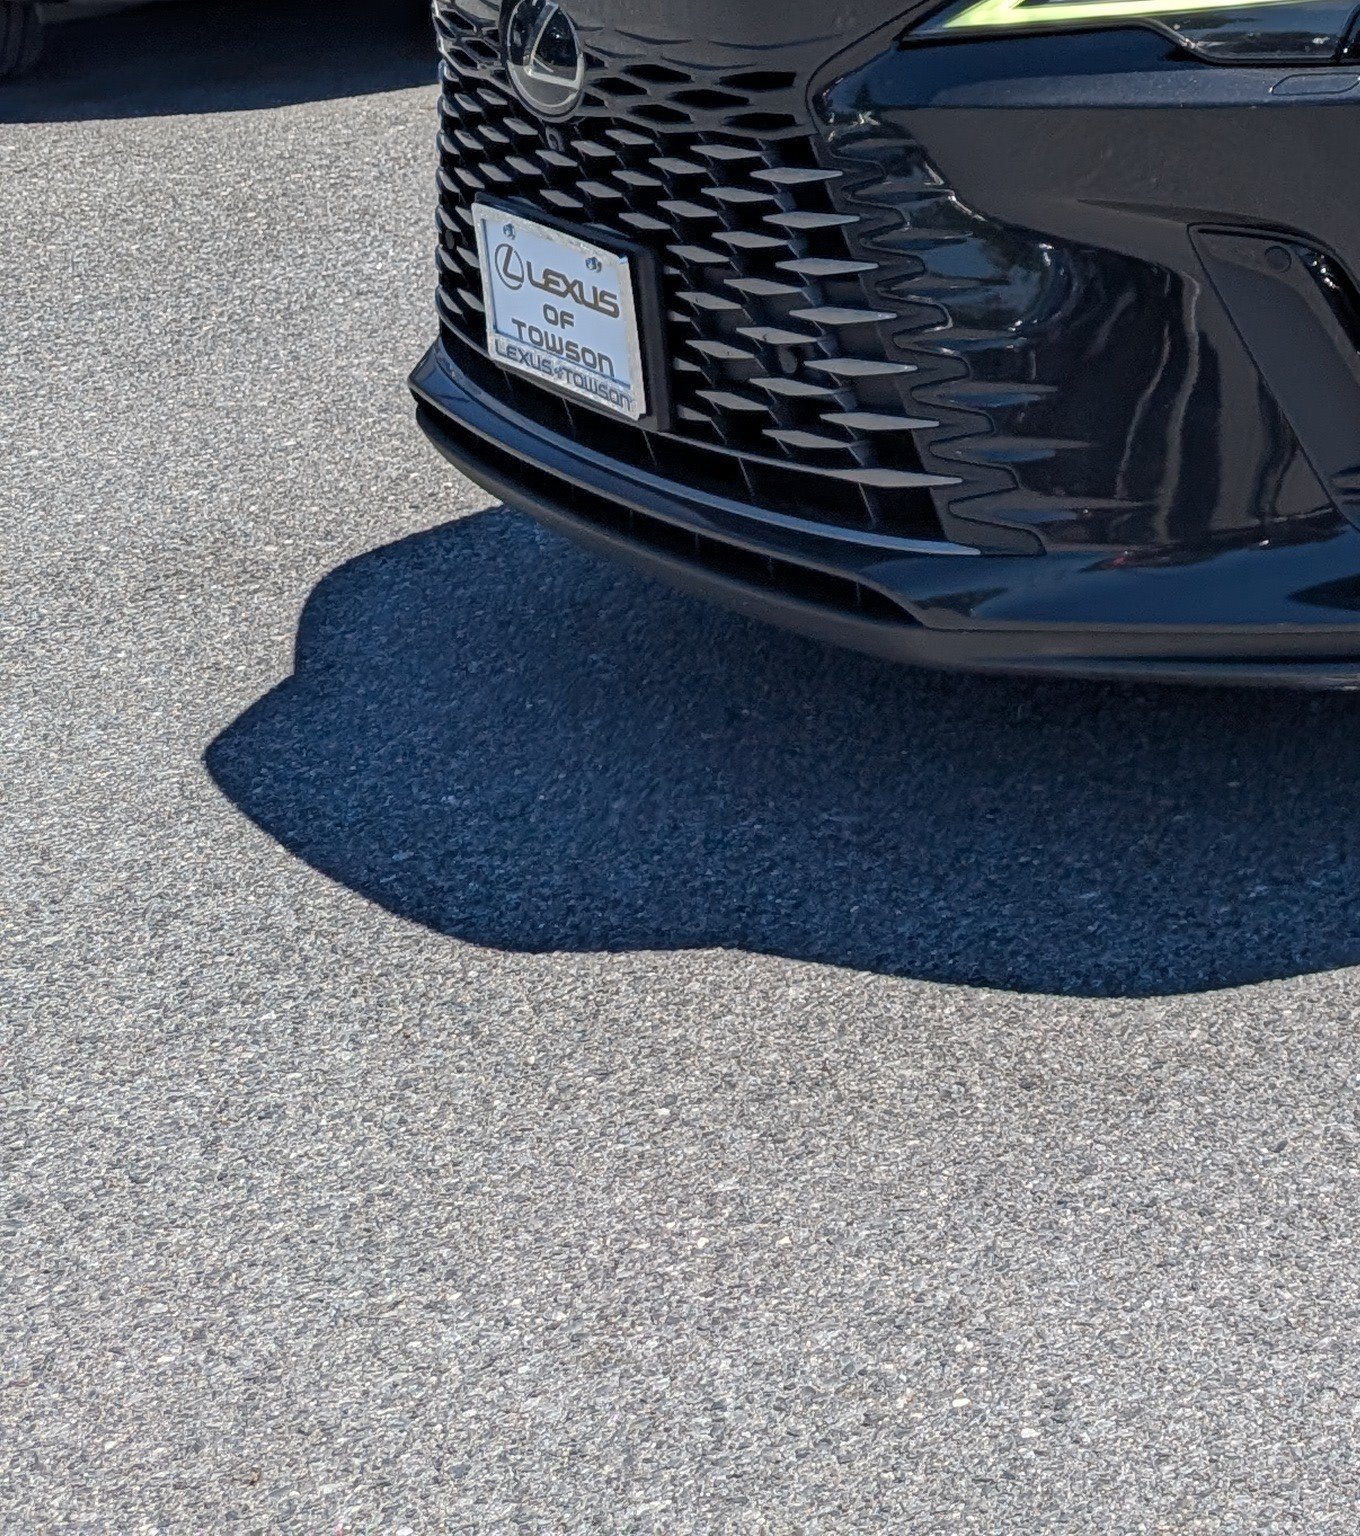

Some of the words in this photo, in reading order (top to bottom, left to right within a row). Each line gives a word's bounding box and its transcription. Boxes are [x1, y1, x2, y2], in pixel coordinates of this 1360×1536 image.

[526, 260, 620, 319] LEXUS
[542, 303, 575, 330] OF
[495, 339, 554, 376] LEXUS
